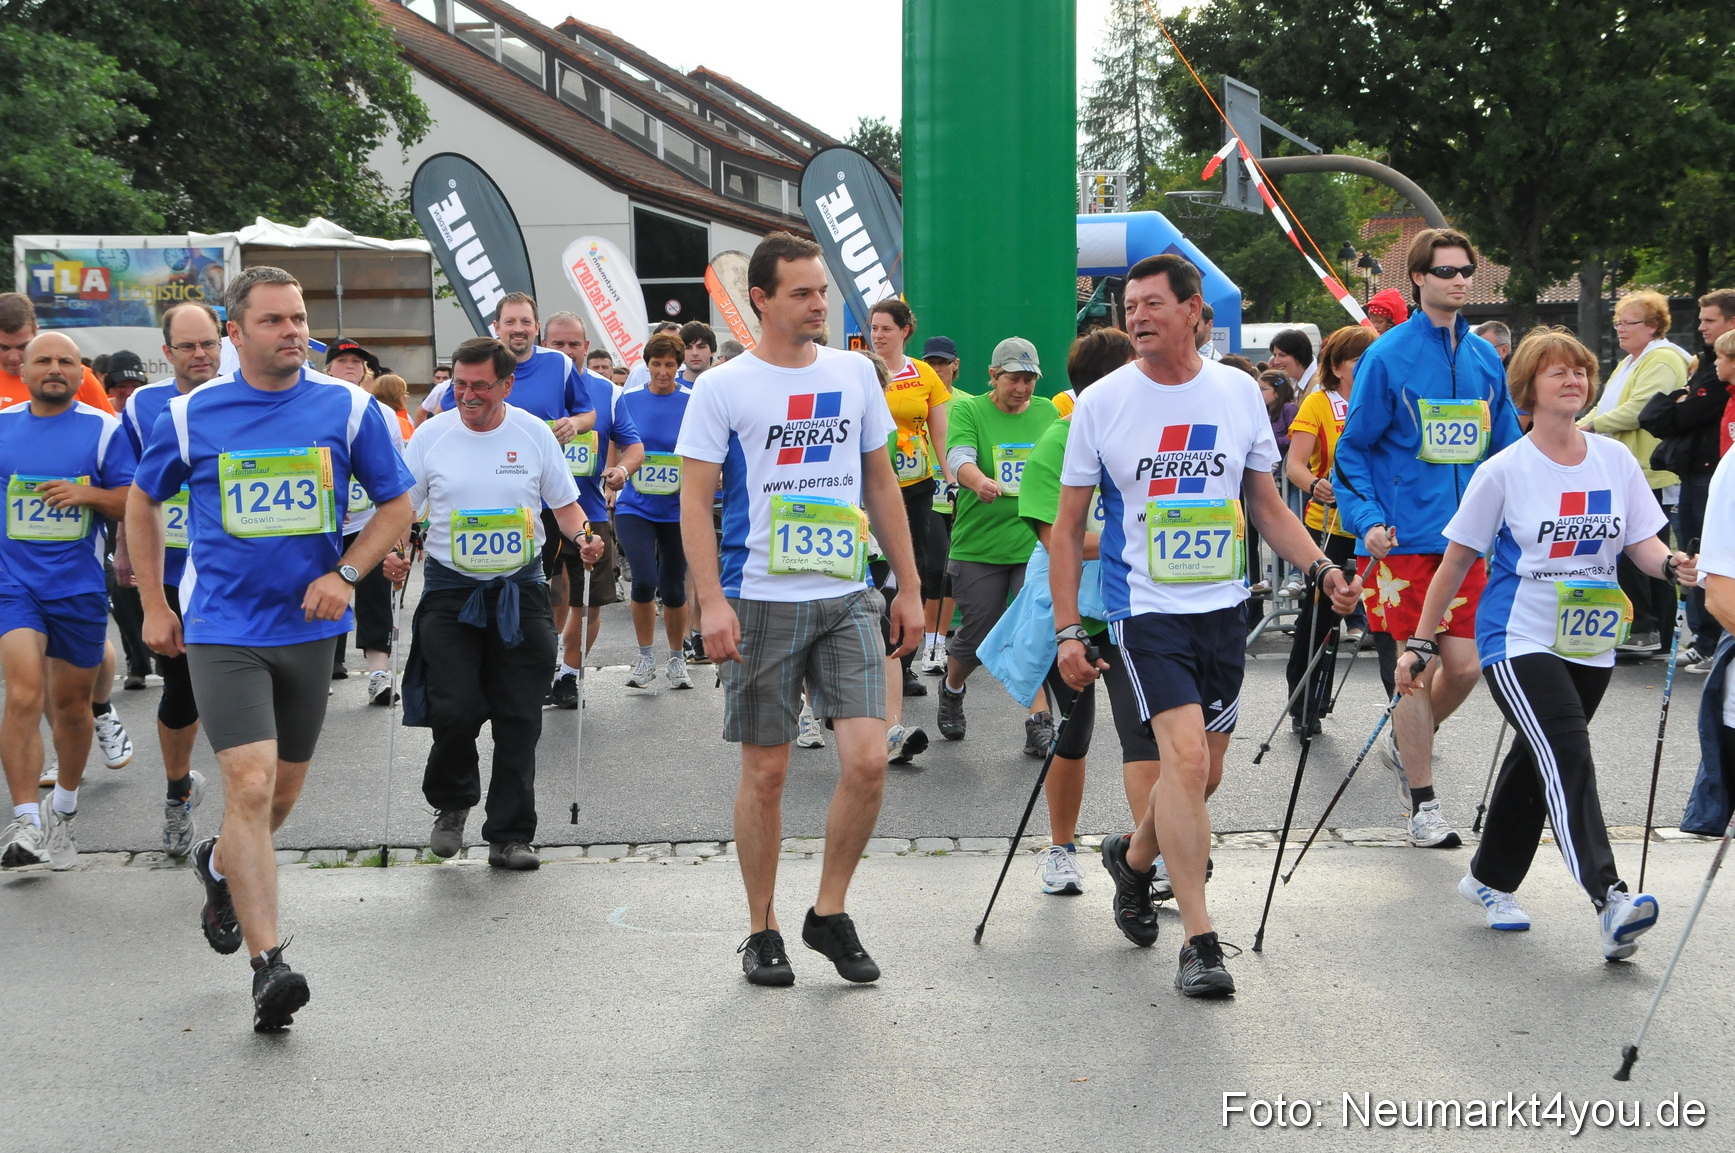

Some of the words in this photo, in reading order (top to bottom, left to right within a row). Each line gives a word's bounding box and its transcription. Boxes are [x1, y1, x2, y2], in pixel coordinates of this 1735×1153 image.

[33, 268, 108, 293] TLA
[119, 279, 205, 305] Logistics
[896, 381, 924, 391] BÖGL
[765, 419, 850, 449] PERRAS
[784, 419, 839, 431] AUTOHAUS
[1426, 422, 1478, 446] 1329
[564, 446, 588, 463] 48
[1154, 451, 1213, 463] AUTOHAUS
[235, 467, 270, 475] firmenlauf
[637, 466, 678, 483] 1245
[1001, 462, 1025, 482] 85
[1136, 453, 1227, 481] PERRAS
[763, 473, 853, 493] www.perras.de
[228, 479, 317, 513] 1243
[12, 498, 82, 522] 1244
[241, 516, 274, 524] Goswin
[1556, 515, 1611, 526] AUTOHAUS
[777, 524, 854, 559] 1333
[1537, 516, 1621, 544] PERRAS
[456, 532, 522, 555] 1208
[1153, 530, 1231, 560] 1257
[1168, 562, 1200, 570] Gerhard
[1561, 608, 1619, 638] 1262
